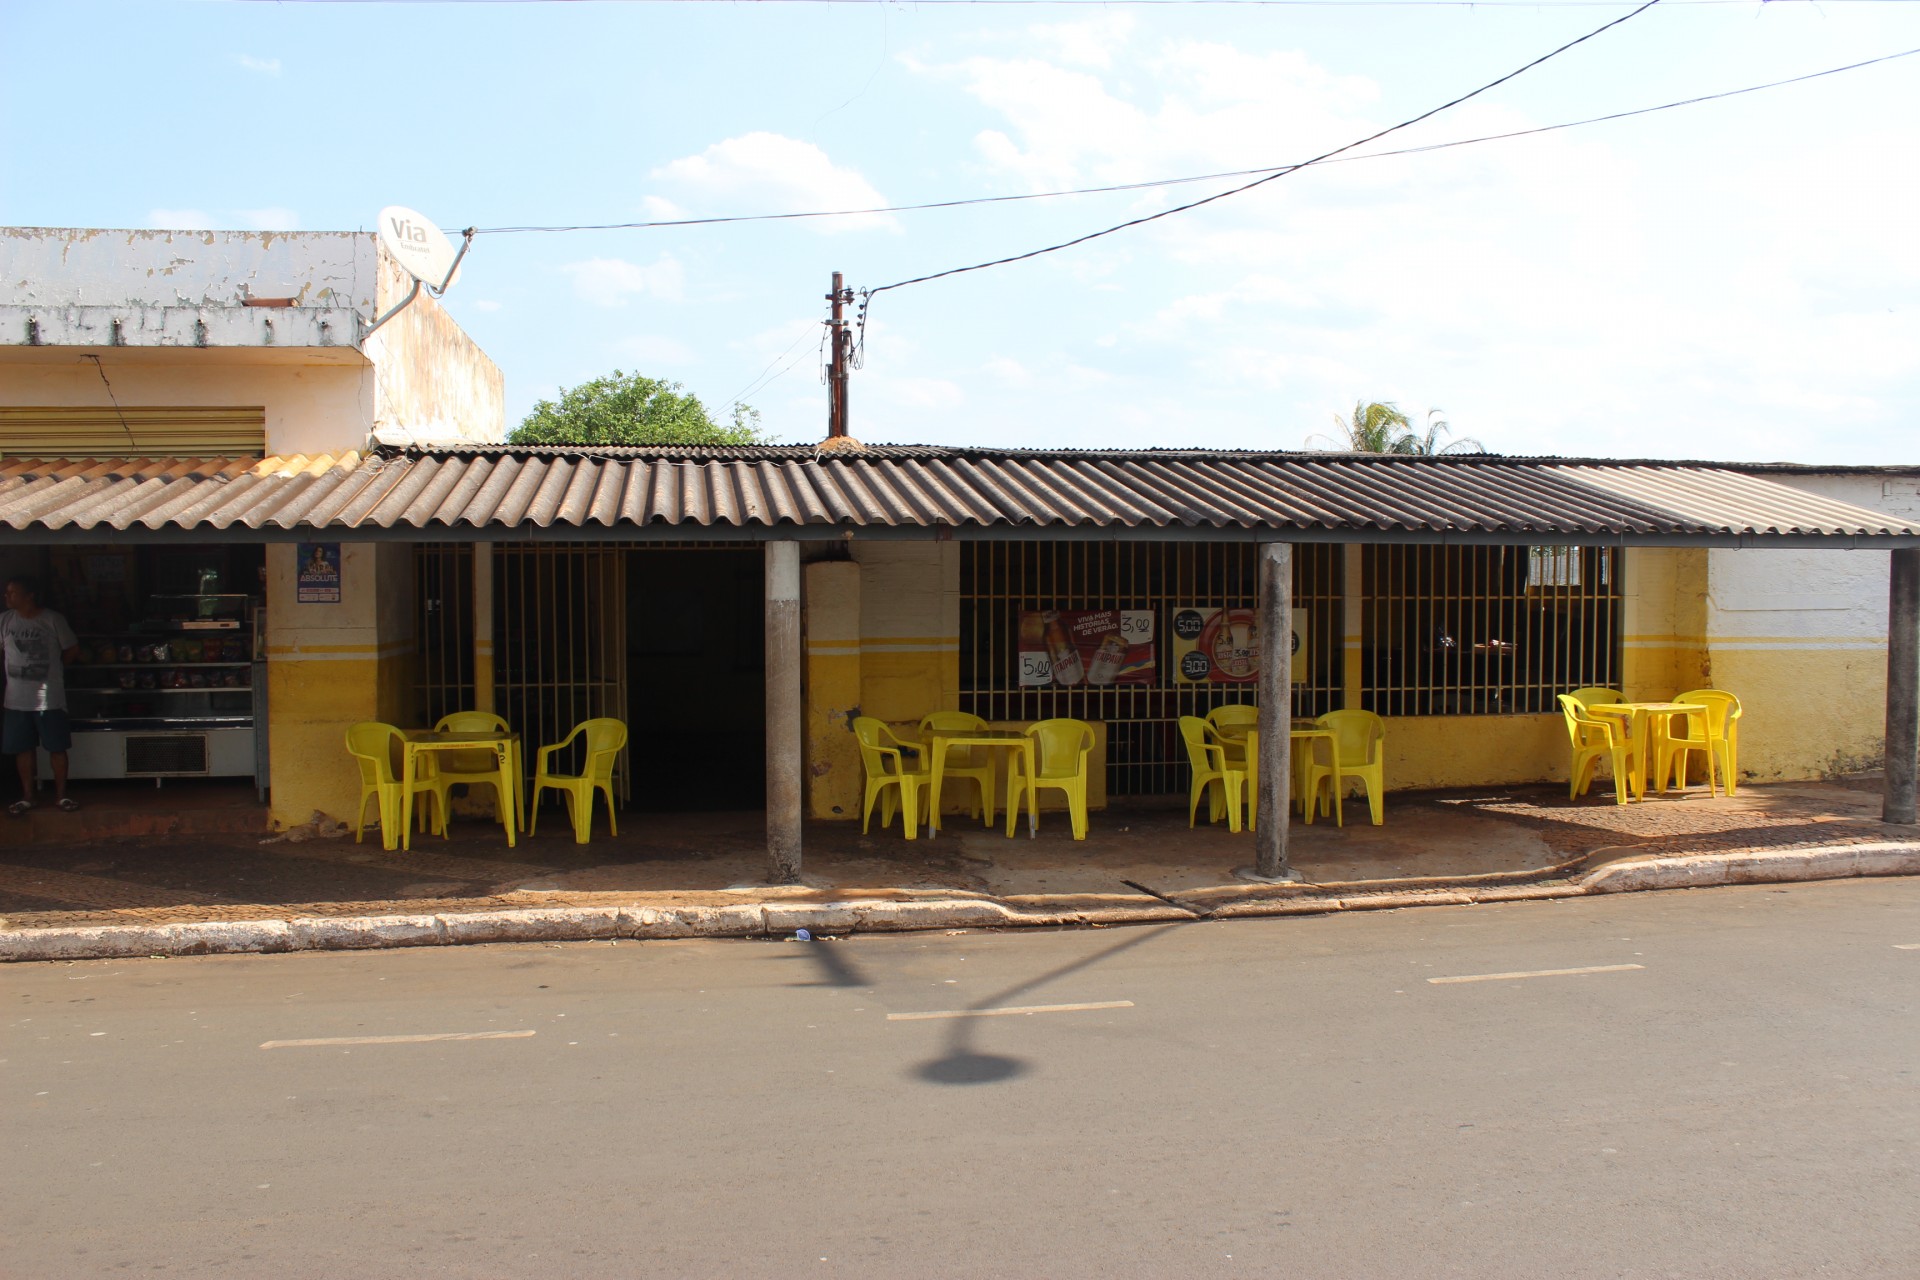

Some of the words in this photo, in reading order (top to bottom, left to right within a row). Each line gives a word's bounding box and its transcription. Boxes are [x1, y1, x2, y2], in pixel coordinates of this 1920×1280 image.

[390, 216, 427, 243] Via
[300, 574, 338, 582] ABSOLUTE
[1077, 614, 1094, 624] VIVA
[1094, 610, 1112, 620] MAIS
[1082, 628, 1093, 636] DE
[1121, 616, 1150, 634] 3,00
[1177, 619, 1201, 632] 5,00
[1055, 653, 1079, 673] ITAIPAVA
[1095, 651, 1121, 665] ITAIPAVA
[1023, 657, 1051, 676] 5,00
[1184, 660, 1208, 674] 3,00
